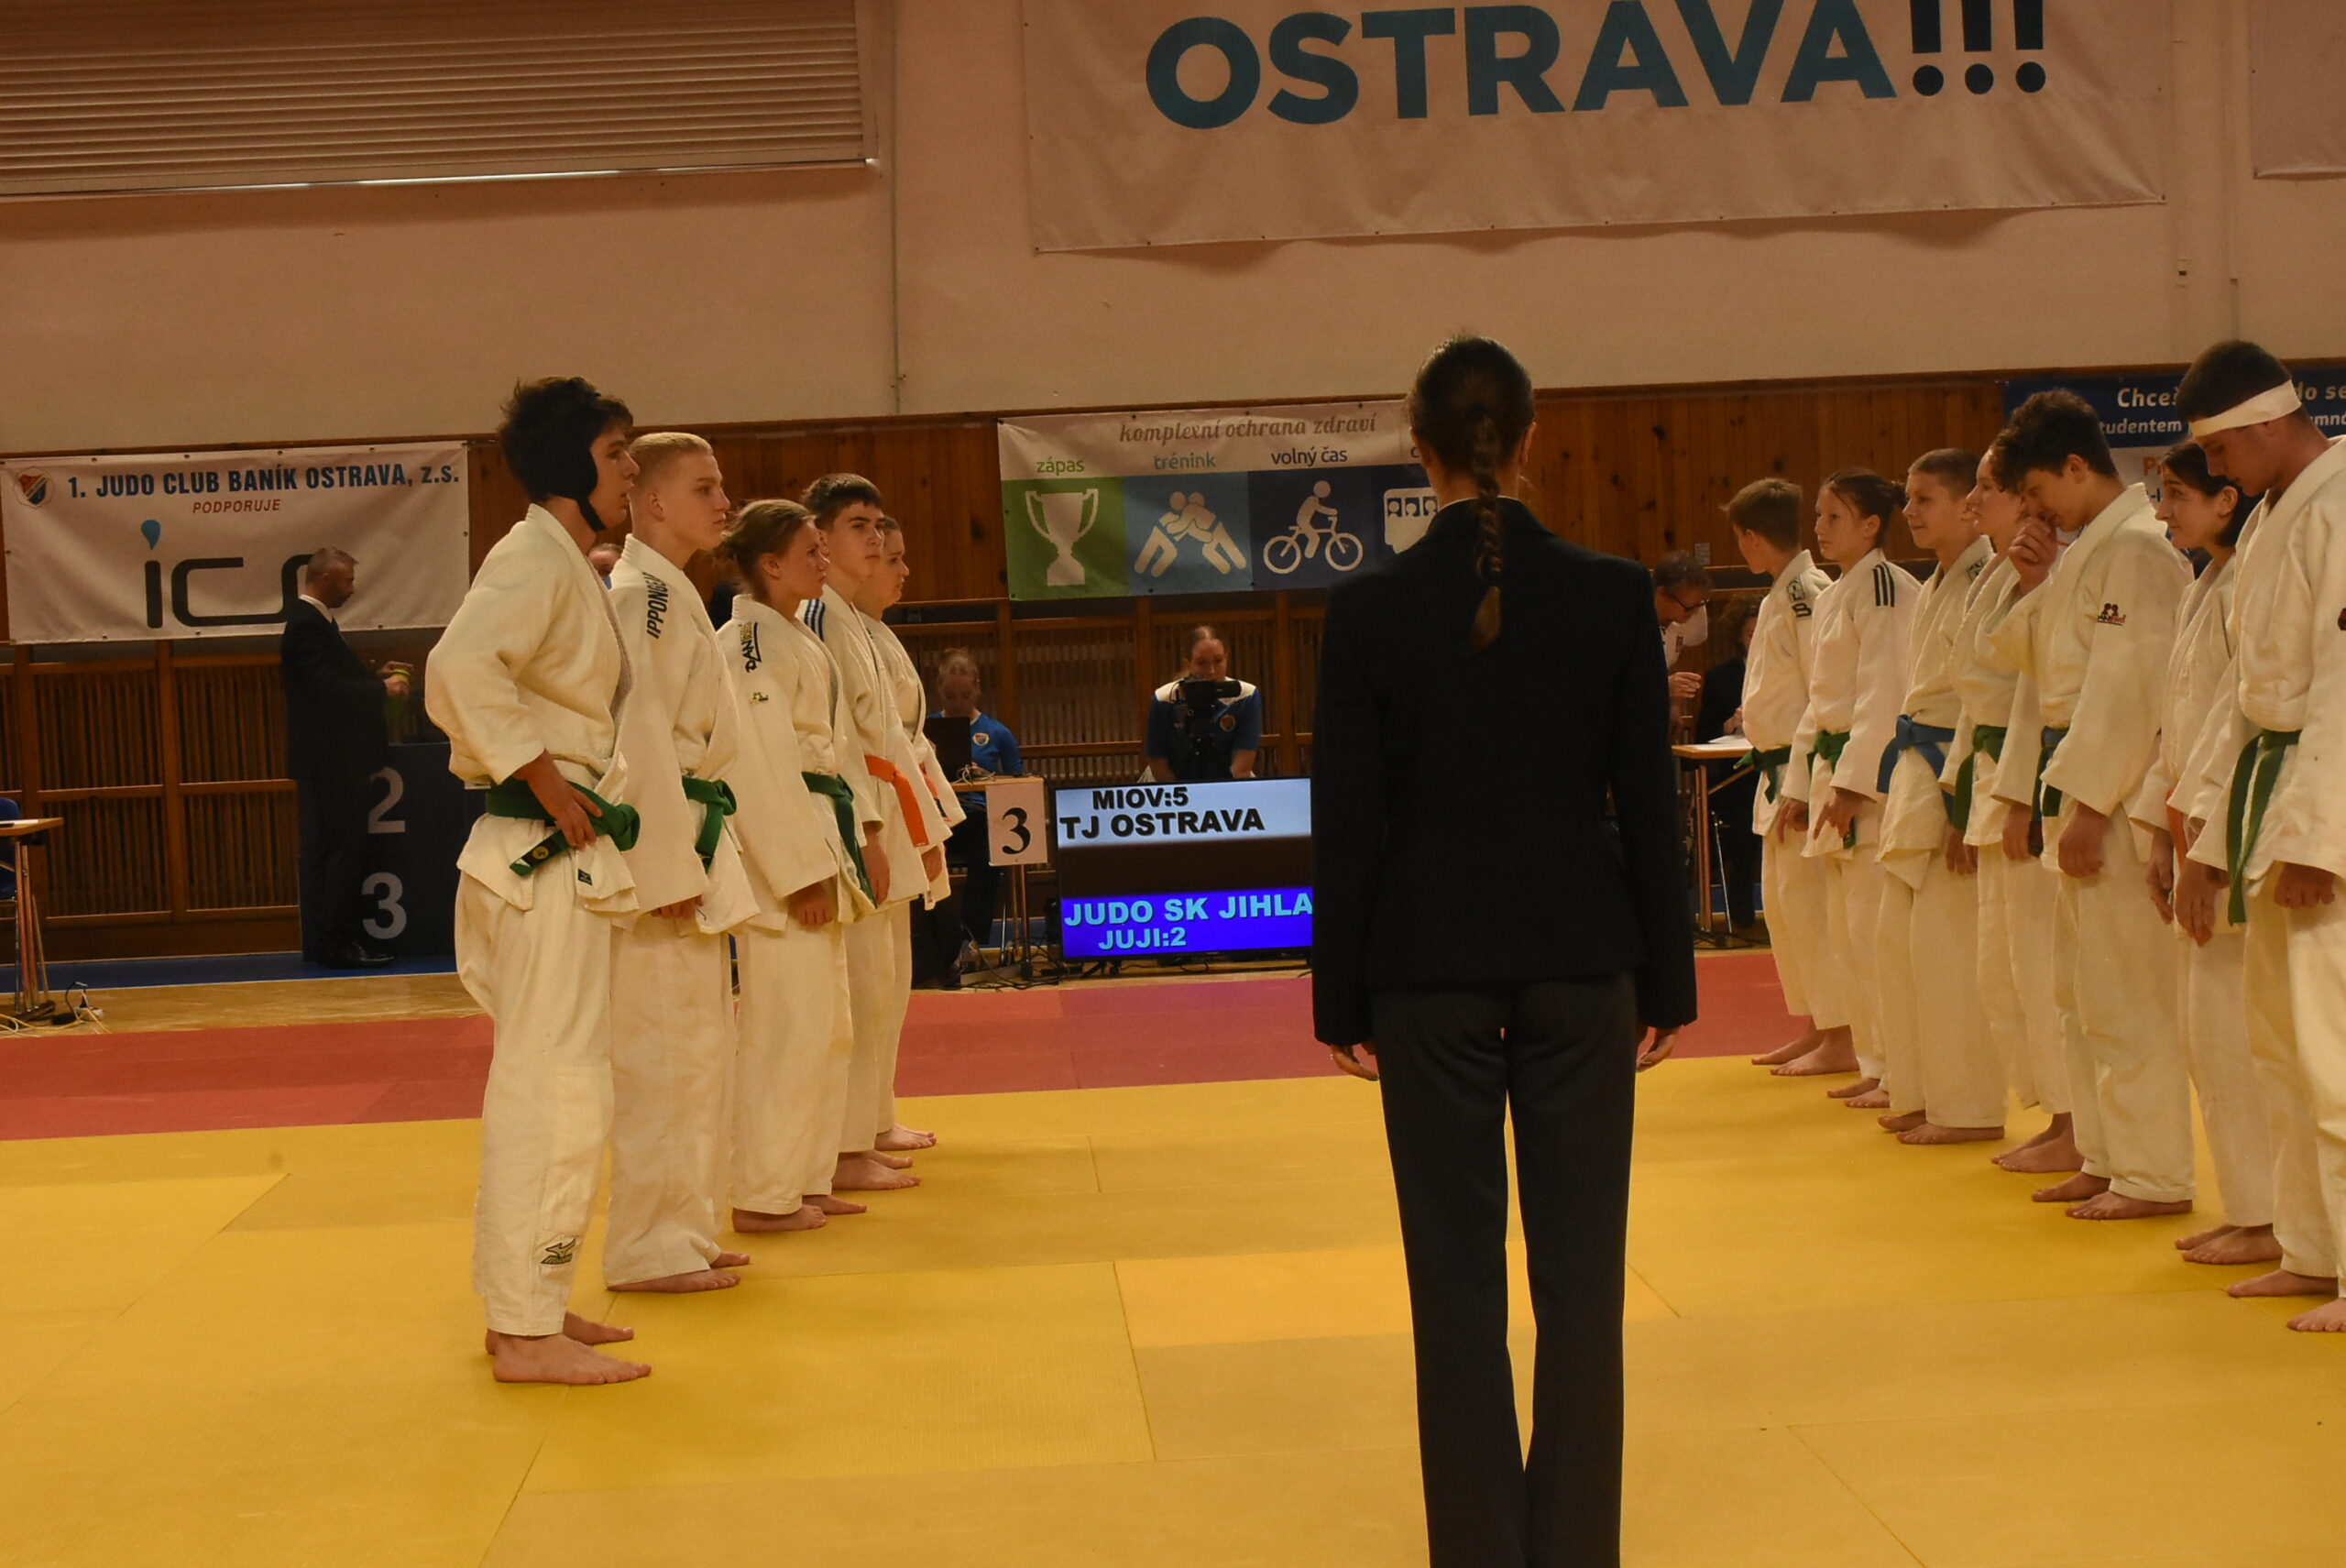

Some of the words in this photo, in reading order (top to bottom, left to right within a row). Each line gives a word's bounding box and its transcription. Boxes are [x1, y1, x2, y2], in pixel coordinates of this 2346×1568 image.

[1146, 0, 2046, 129] OSTRAVA!!!
[1120, 421, 1220, 445] komplexní
[1225, 419, 1307, 438] ochrana
[1312, 413, 1377, 434] zdraví
[1036, 456, 1085, 476] zápas
[1154, 451, 1215, 470] trénink
[1271, 446, 1317, 466] volný
[1321, 445, 1348, 462] čas
[68, 477, 86, 498] 1.
[96, 473, 155, 497] JUDO
[163, 470, 220, 494] CLUB
[228, 465, 298, 492] BANÍK
[305, 463, 412, 489] OSTRAVA,
[192, 499, 280, 514] PODPORUJE
[367, 766, 406, 835] 2
[1091, 786, 1189, 810] MIOV:5
[1001, 807, 1032, 854] 3
[1059, 816, 1100, 839] TJ
[1111, 807, 1266, 838] OSTRAVA
[361, 872, 407, 939] 3
[1063, 900, 1154, 927] JUDO
[1164, 897, 1210, 923] SK
[1098, 927, 1187, 951] JUJI:2
